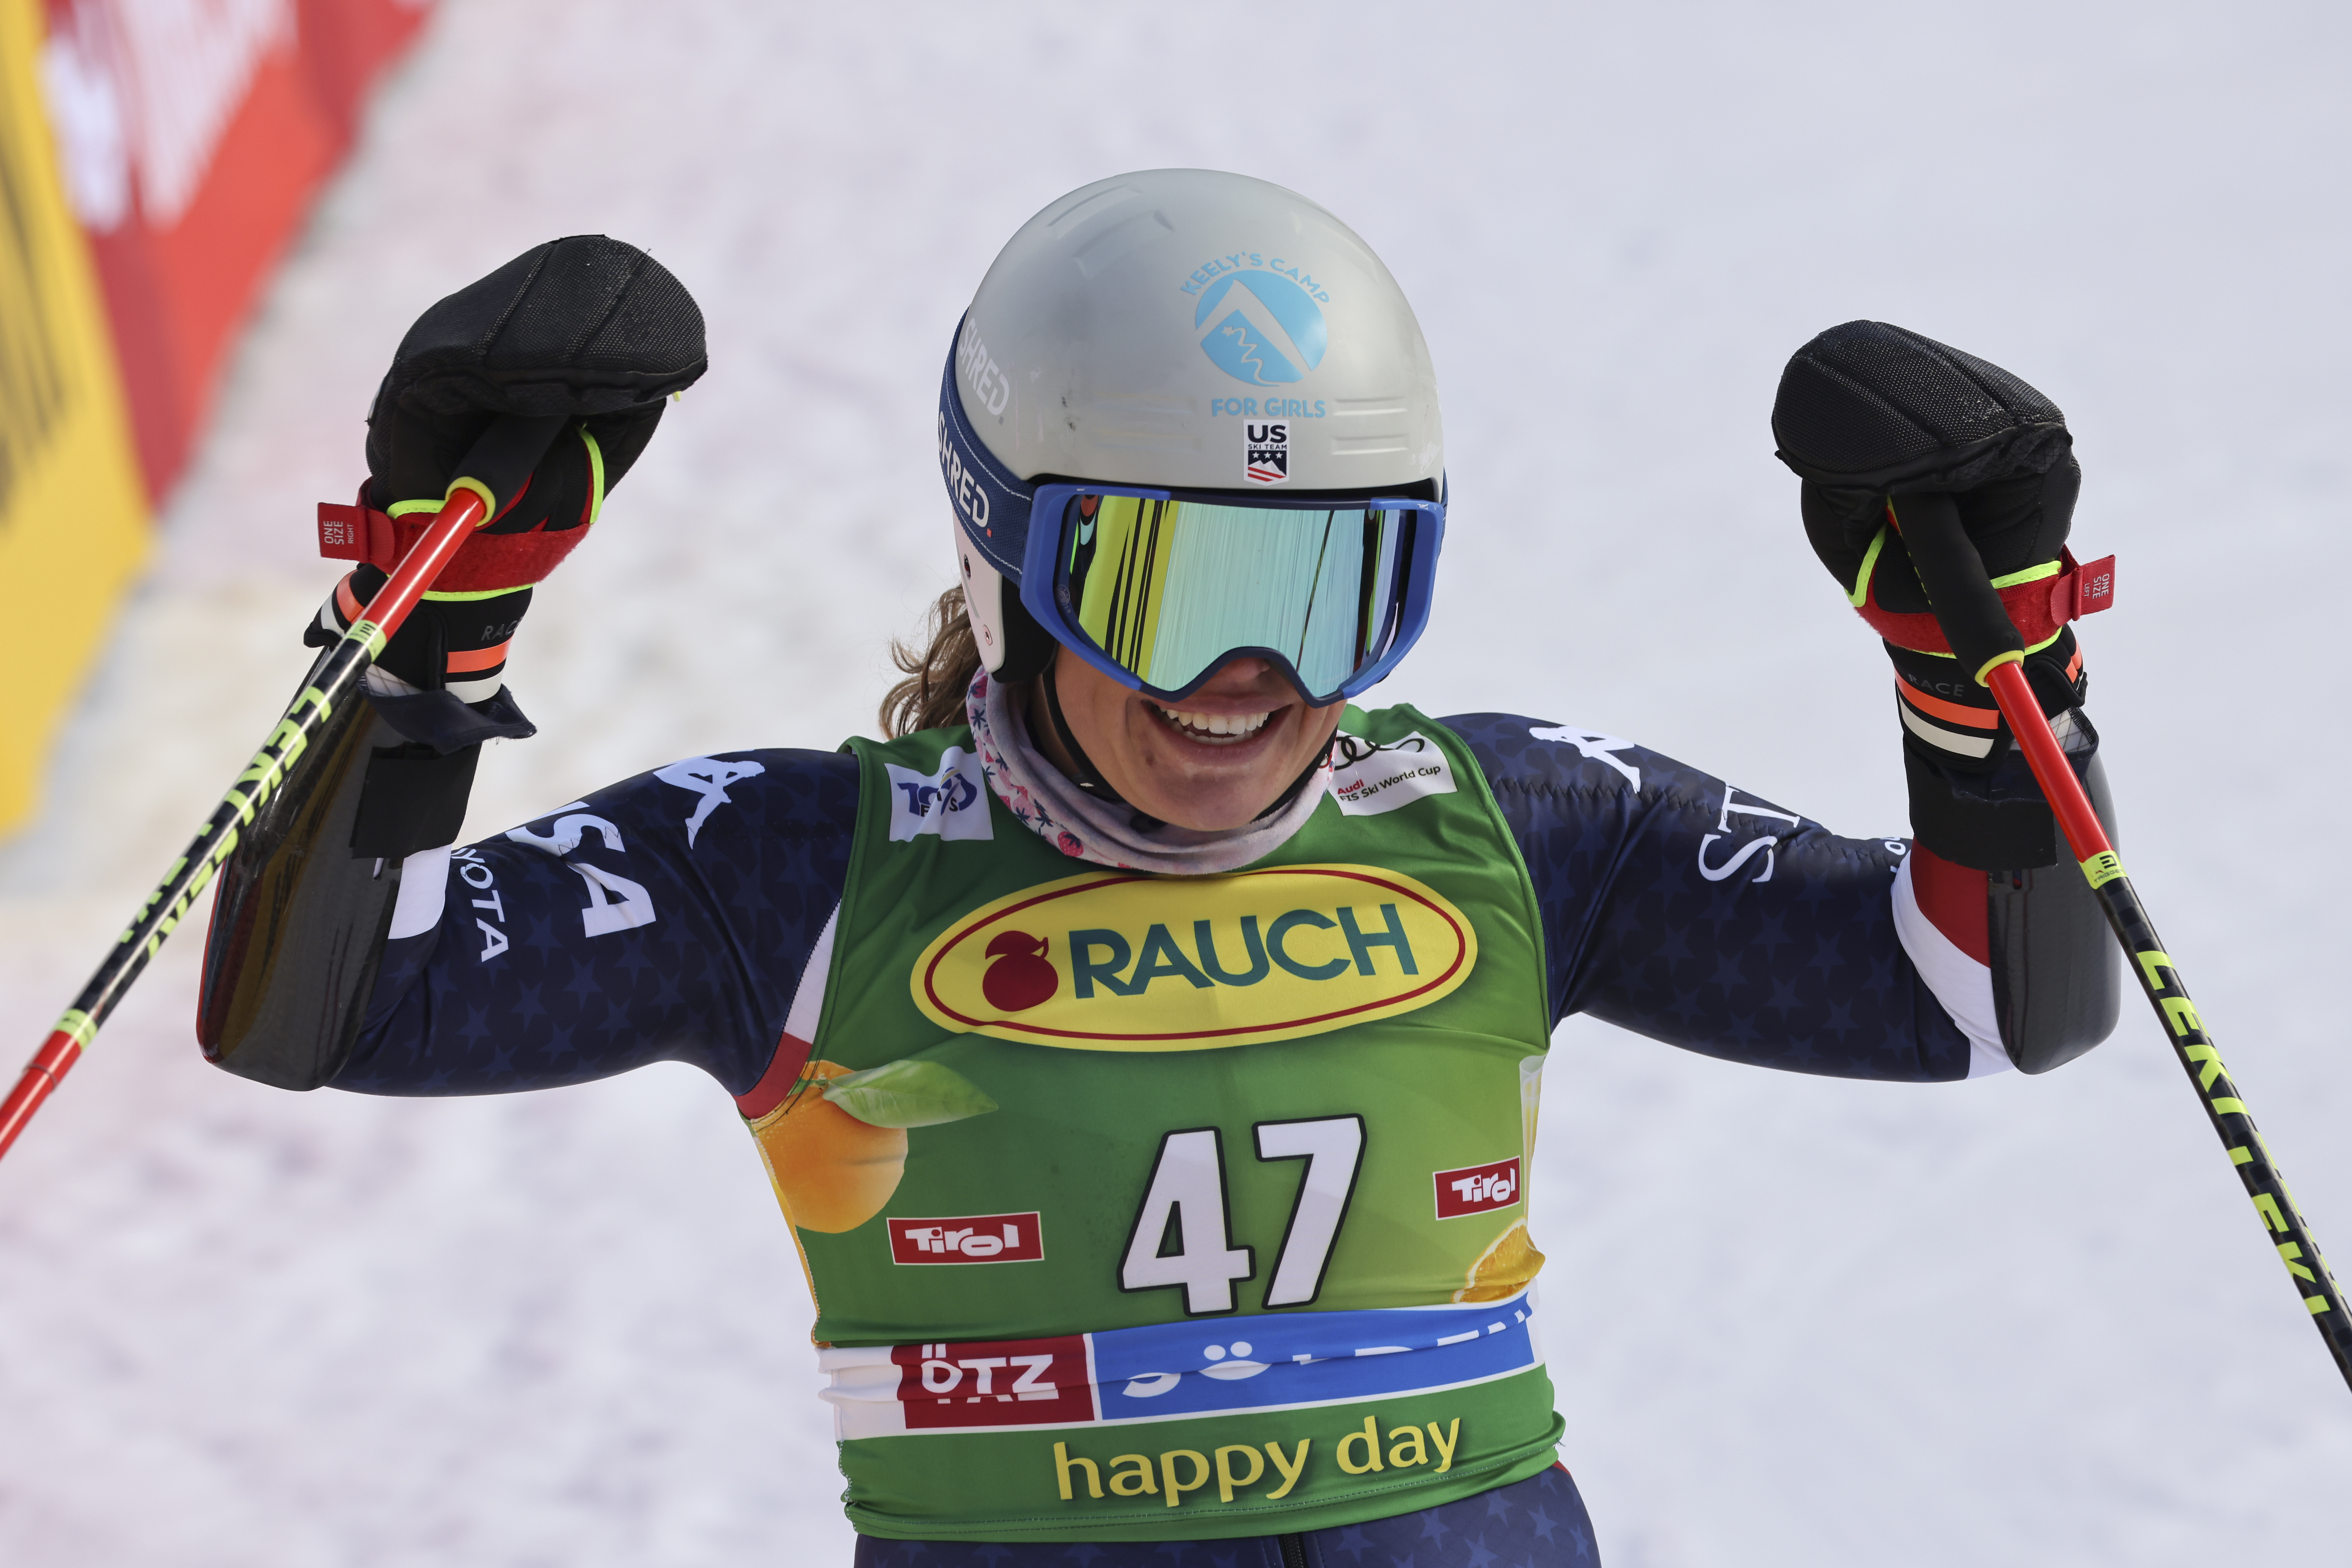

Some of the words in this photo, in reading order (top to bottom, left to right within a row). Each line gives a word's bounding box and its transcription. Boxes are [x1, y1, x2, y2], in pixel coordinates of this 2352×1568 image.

[1180, 251, 1263, 295] KEELY'S
[1271, 258, 1329, 302] CAMP
[1212, 398, 1258, 417] FOR
[1265, 398, 1326, 418] GIRLS
[1248, 425, 1287, 443] US
[323, 521, 334, 544] ONE
[334, 521, 344, 545] SIZE
[2092, 576, 2101, 599] SIZE
[2101, 574, 2109, 596] ONE
[1908, 673, 1964, 697] RACE
[1338, 779, 1364, 795] Audi
[1363, 785, 1379, 798] Ski
[1379, 771, 1415, 789] World
[1418, 766, 1441, 777] Cup
[505, 801, 657, 938] SA
[450, 848, 509, 963] YOTA
[1068, 903, 1419, 999] RAUCH
[2136, 950, 2250, 1115] LEKI
[1452, 1167, 1516, 1202] Tirol
[1117, 1113, 1367, 1317] 47
[905, 1223, 1019, 1256] Tirol
[1053, 1438, 1311, 1507] happy
[1336, 1415, 1461, 1473] day
